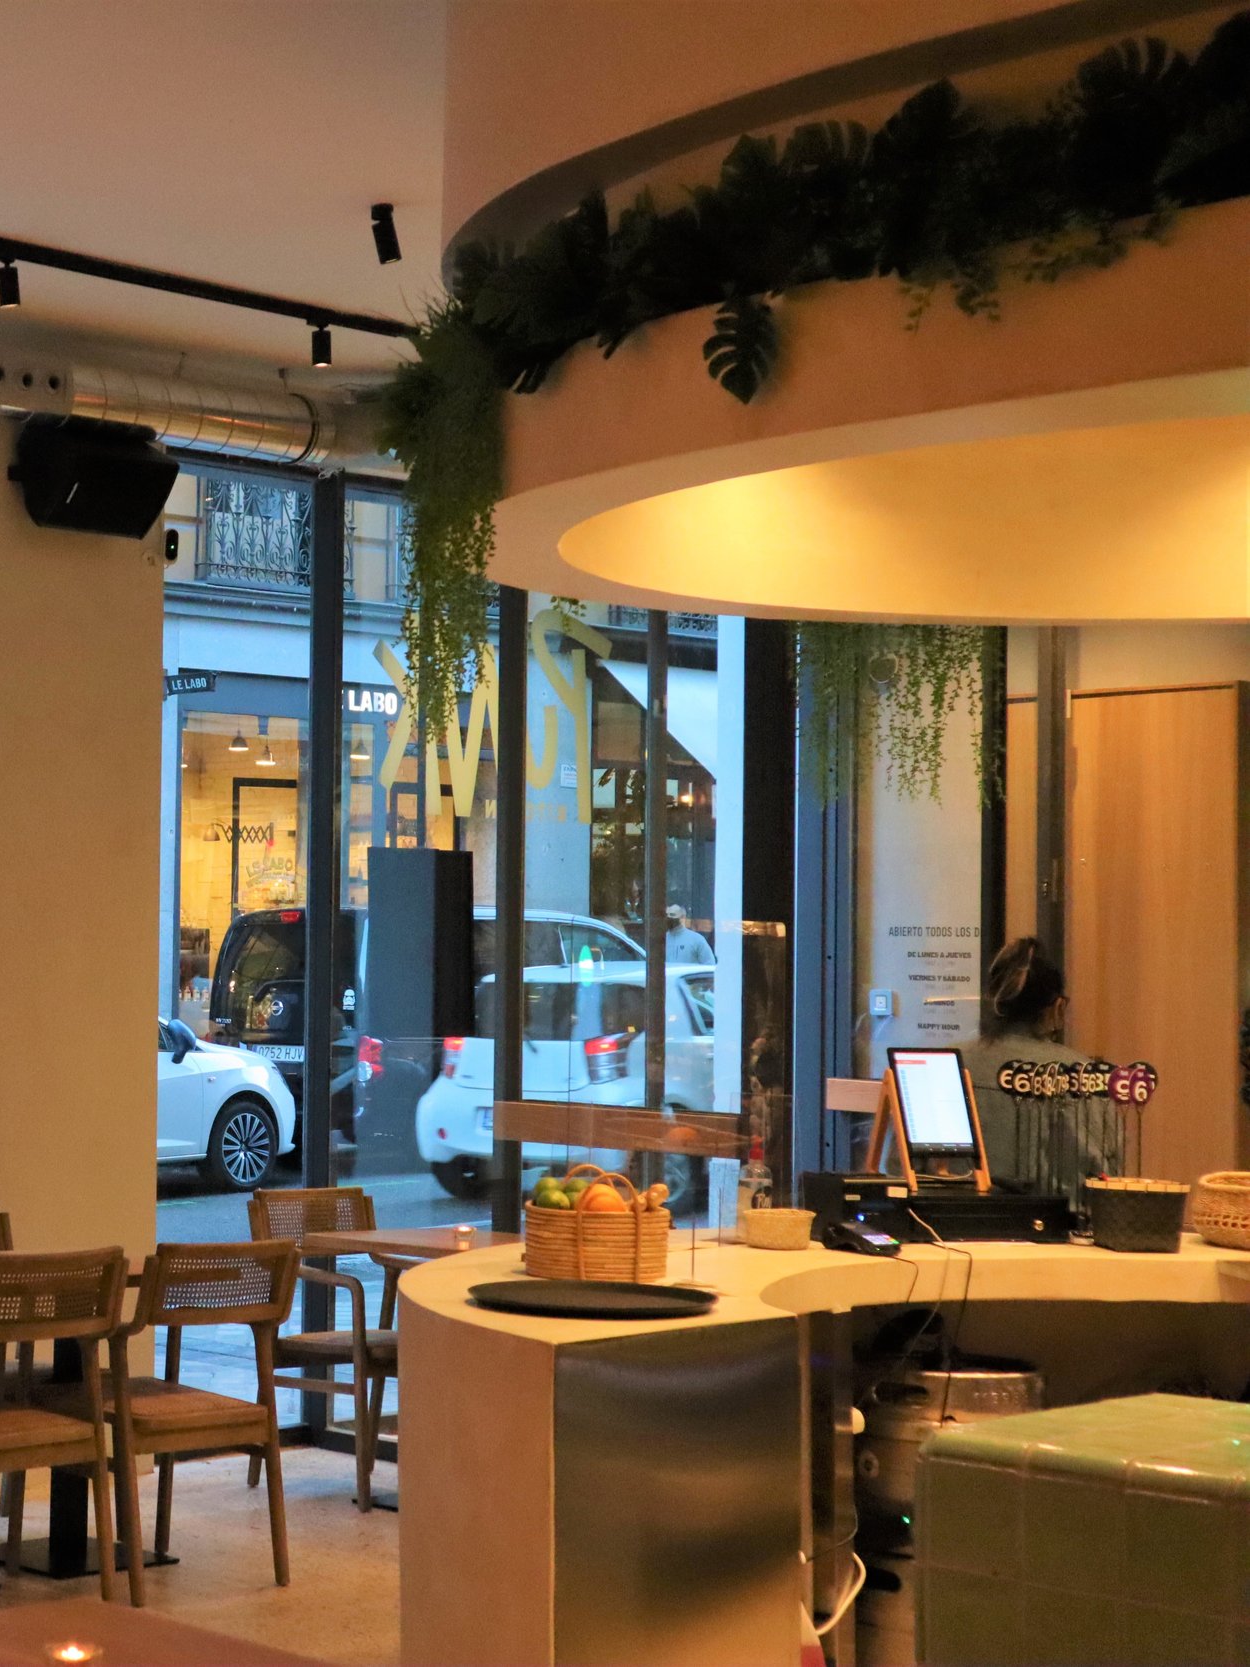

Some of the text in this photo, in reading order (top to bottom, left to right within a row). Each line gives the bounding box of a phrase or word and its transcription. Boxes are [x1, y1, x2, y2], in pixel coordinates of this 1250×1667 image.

[171, 677, 207, 691] LE LABO
[348, 689, 398, 715] LABO
[888, 926, 923, 937] ABIERTO
[925, 926, 953, 938] TODOS
[955, 927, 971, 938] LOS
[258, 1046, 303, 1060] 0752 HJV
